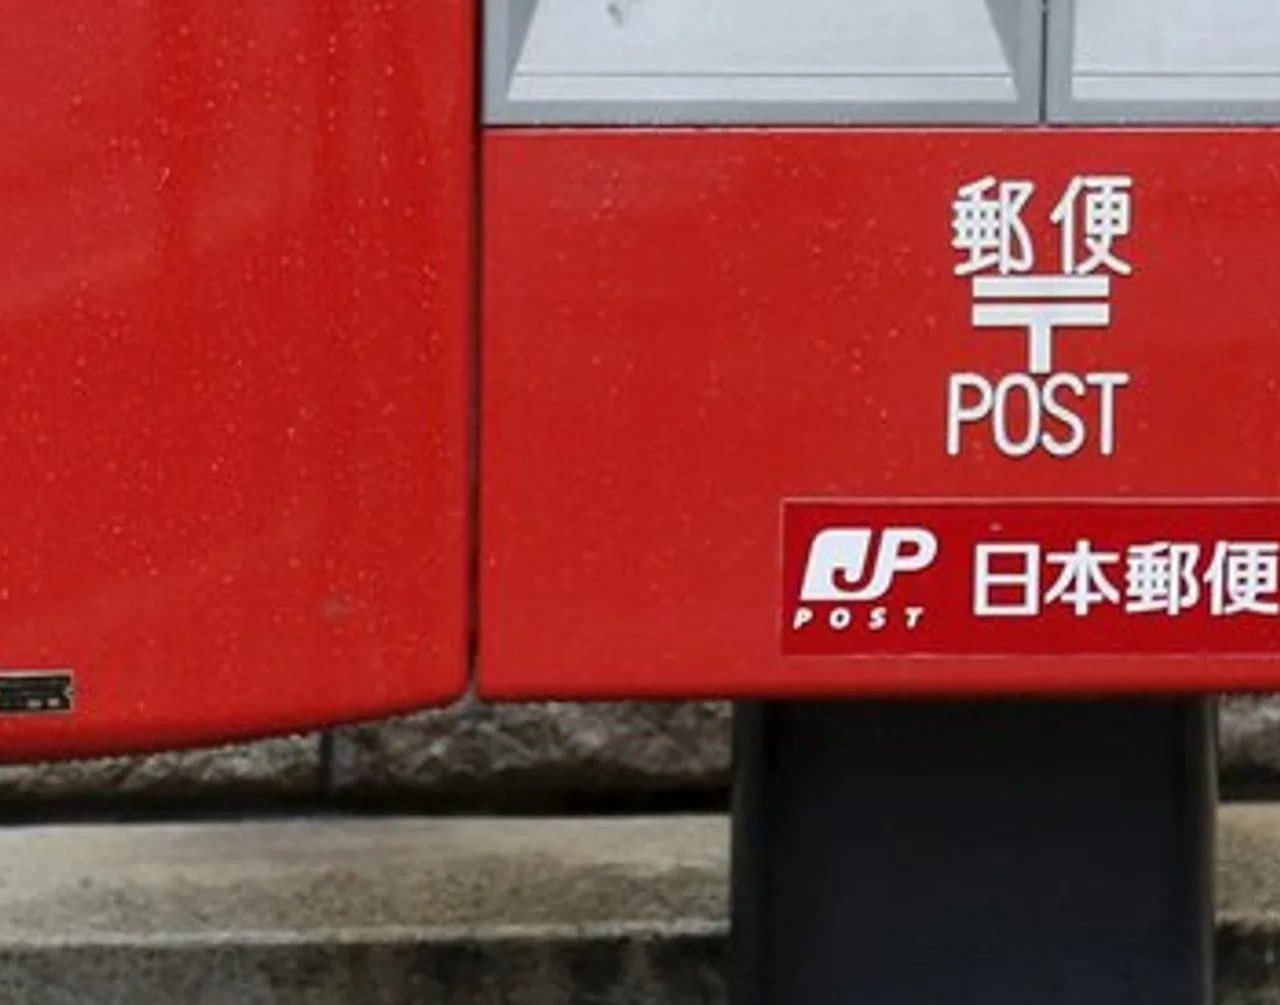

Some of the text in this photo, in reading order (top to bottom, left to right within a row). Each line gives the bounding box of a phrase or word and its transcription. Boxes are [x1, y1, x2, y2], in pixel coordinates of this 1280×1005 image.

[950, 175, 1133, 276] 郵便
[946, 372, 1130, 456] POST
[793, 607, 926, 630] POST
[972, 540, 1280, 617] 日本郵便
